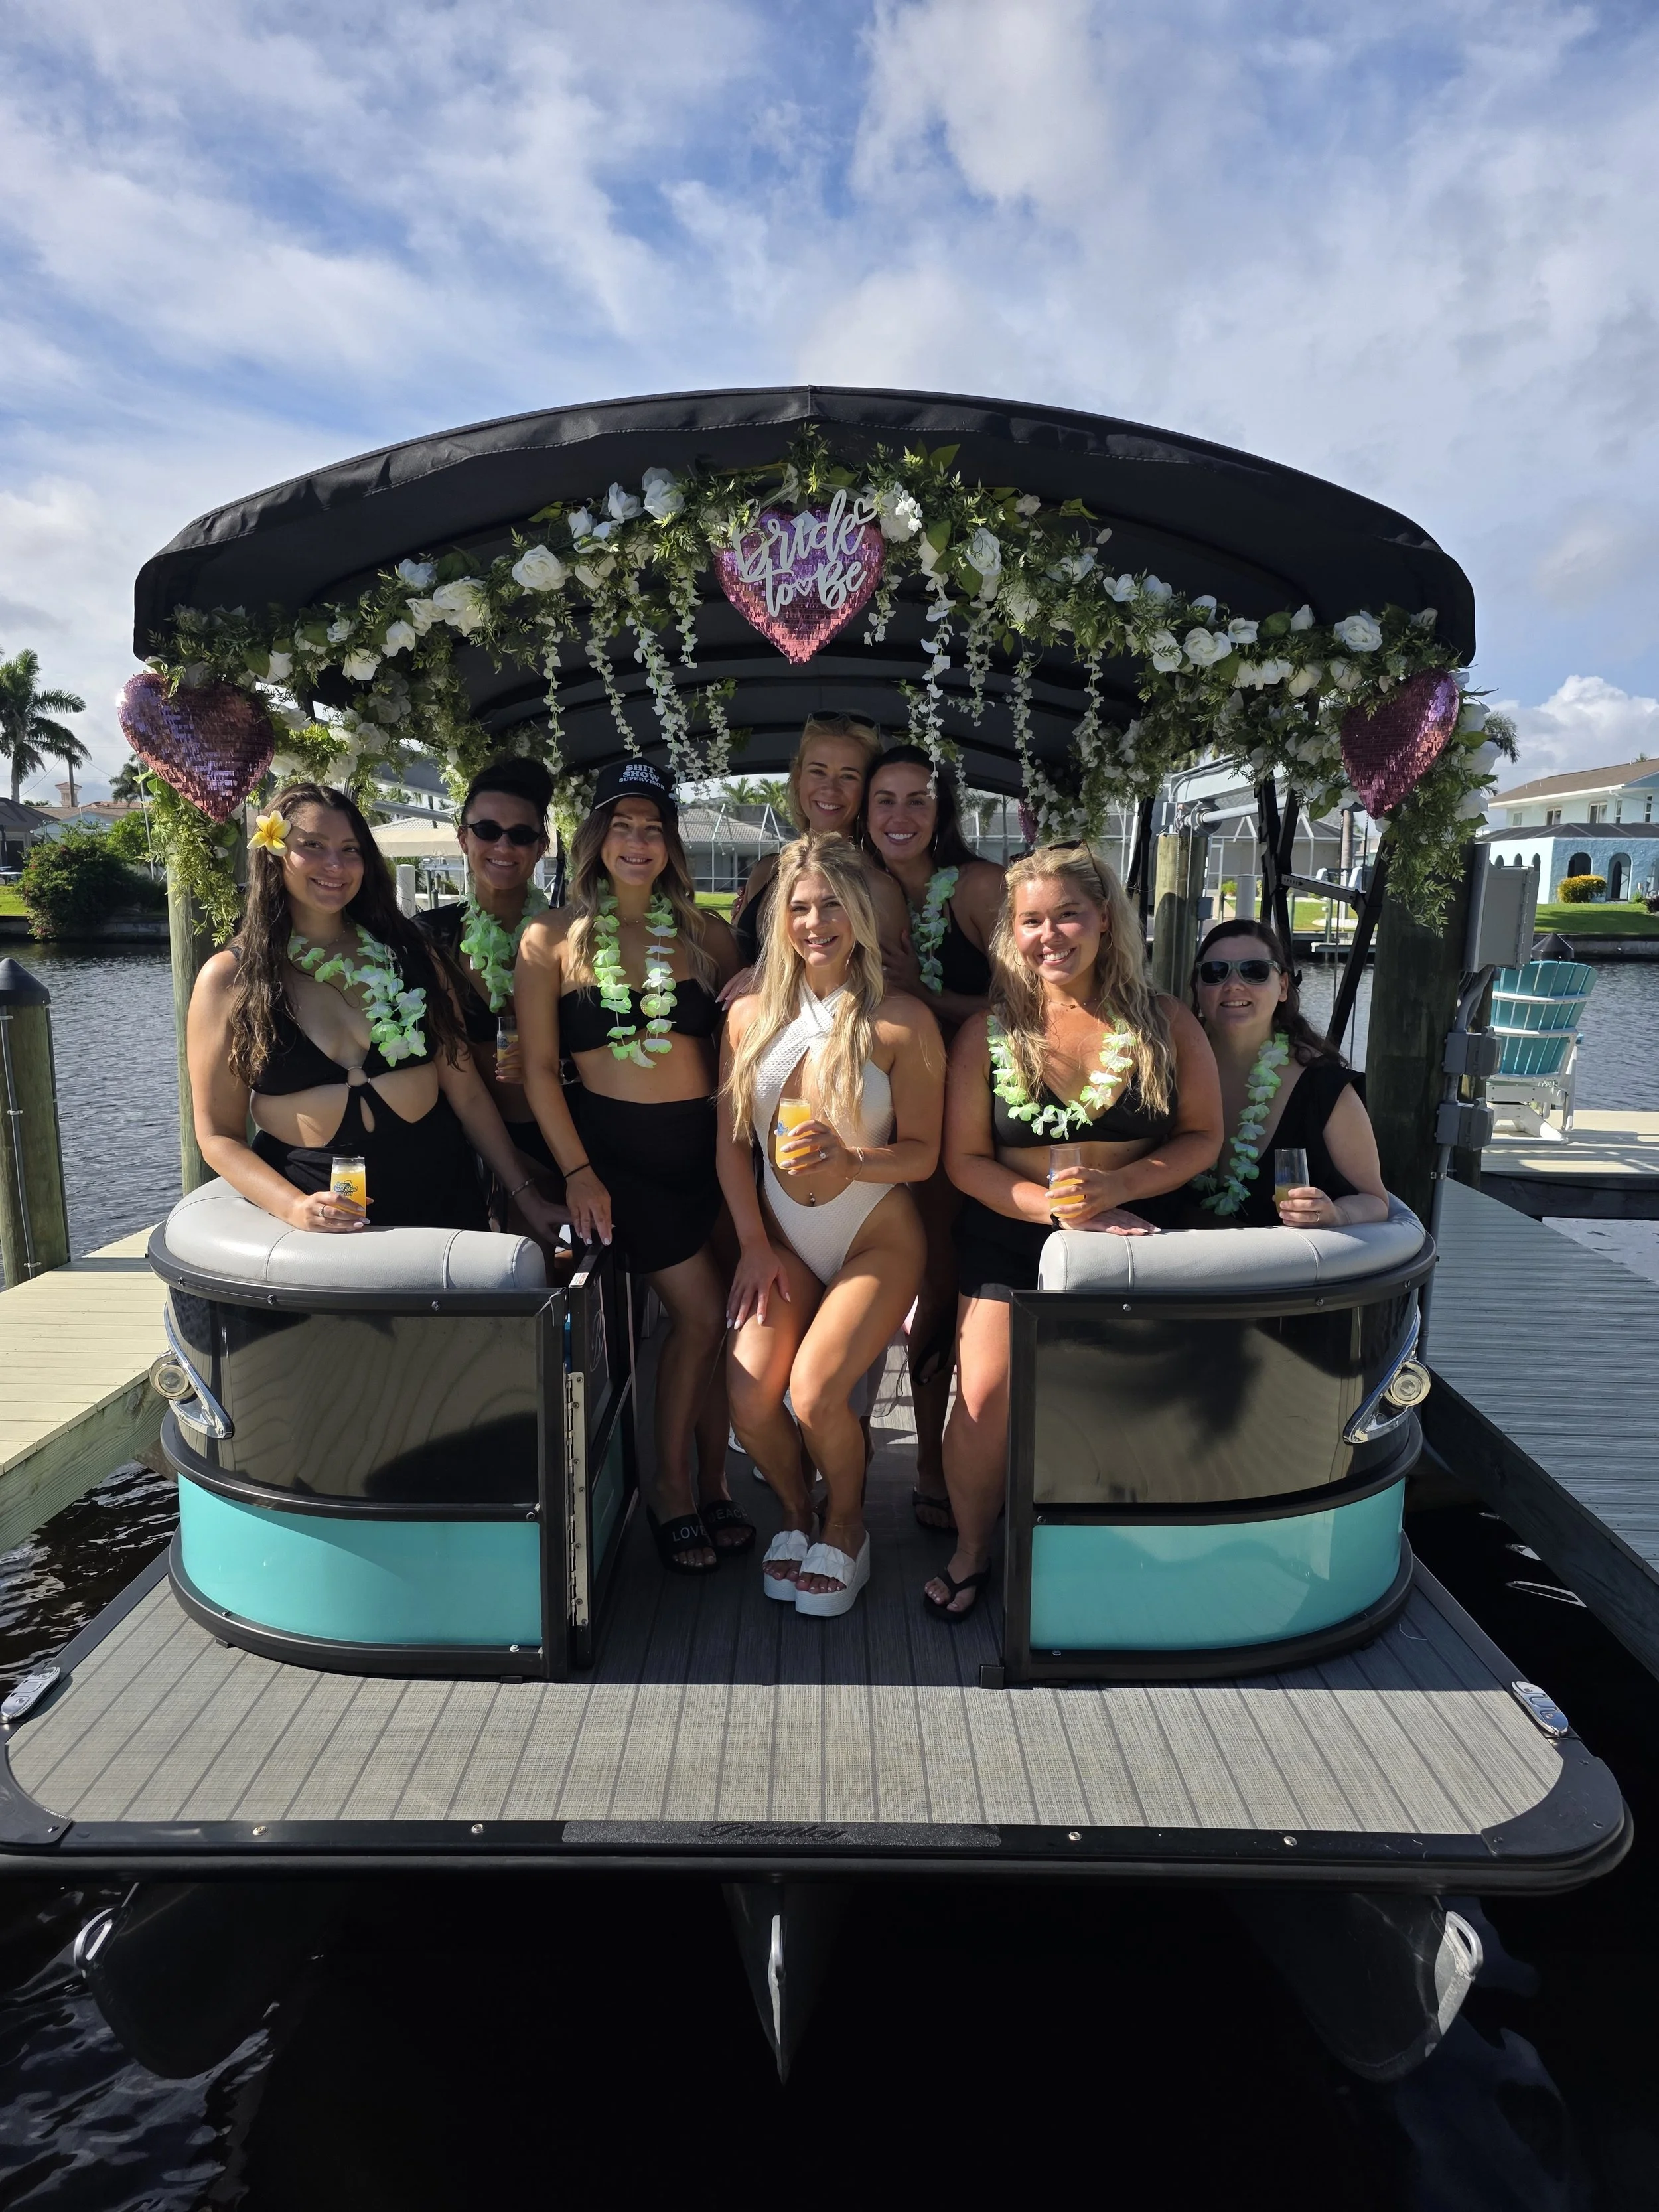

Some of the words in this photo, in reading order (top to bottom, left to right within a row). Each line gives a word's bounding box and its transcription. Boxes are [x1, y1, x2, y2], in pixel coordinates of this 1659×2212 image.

[626, 764, 656, 774] SHIT
[623, 771, 660, 782] SHOW
[619, 776, 665, 790] SUPERVISOR
[672, 1525, 708, 1542] LOVE
